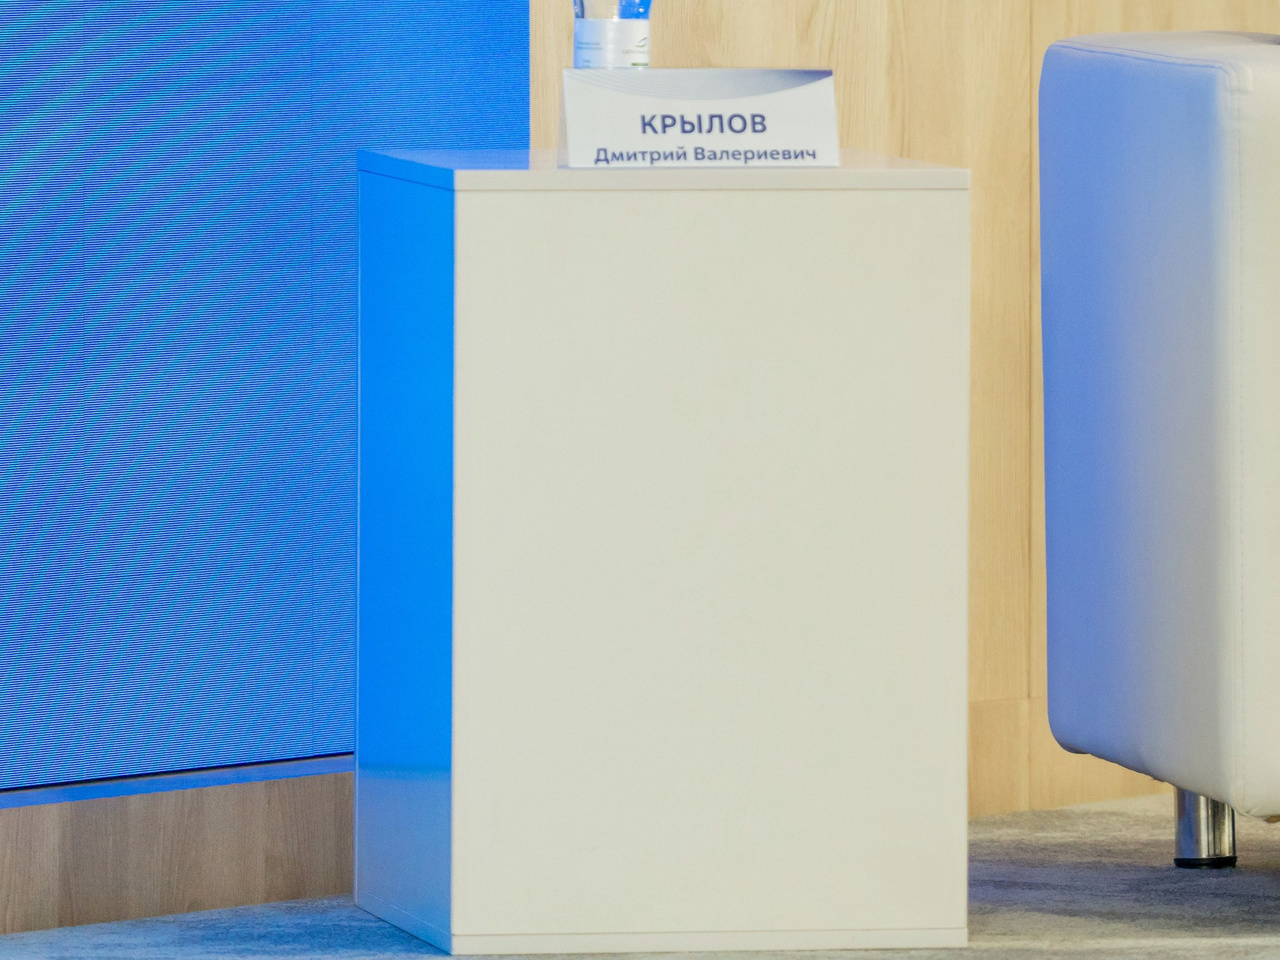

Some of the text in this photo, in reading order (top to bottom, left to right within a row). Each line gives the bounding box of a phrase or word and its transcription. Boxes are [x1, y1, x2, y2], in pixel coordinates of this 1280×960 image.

[640, 113, 768, 135] КРЫЛОВ
[594, 146, 817, 165] Дмитрий Валериевич
